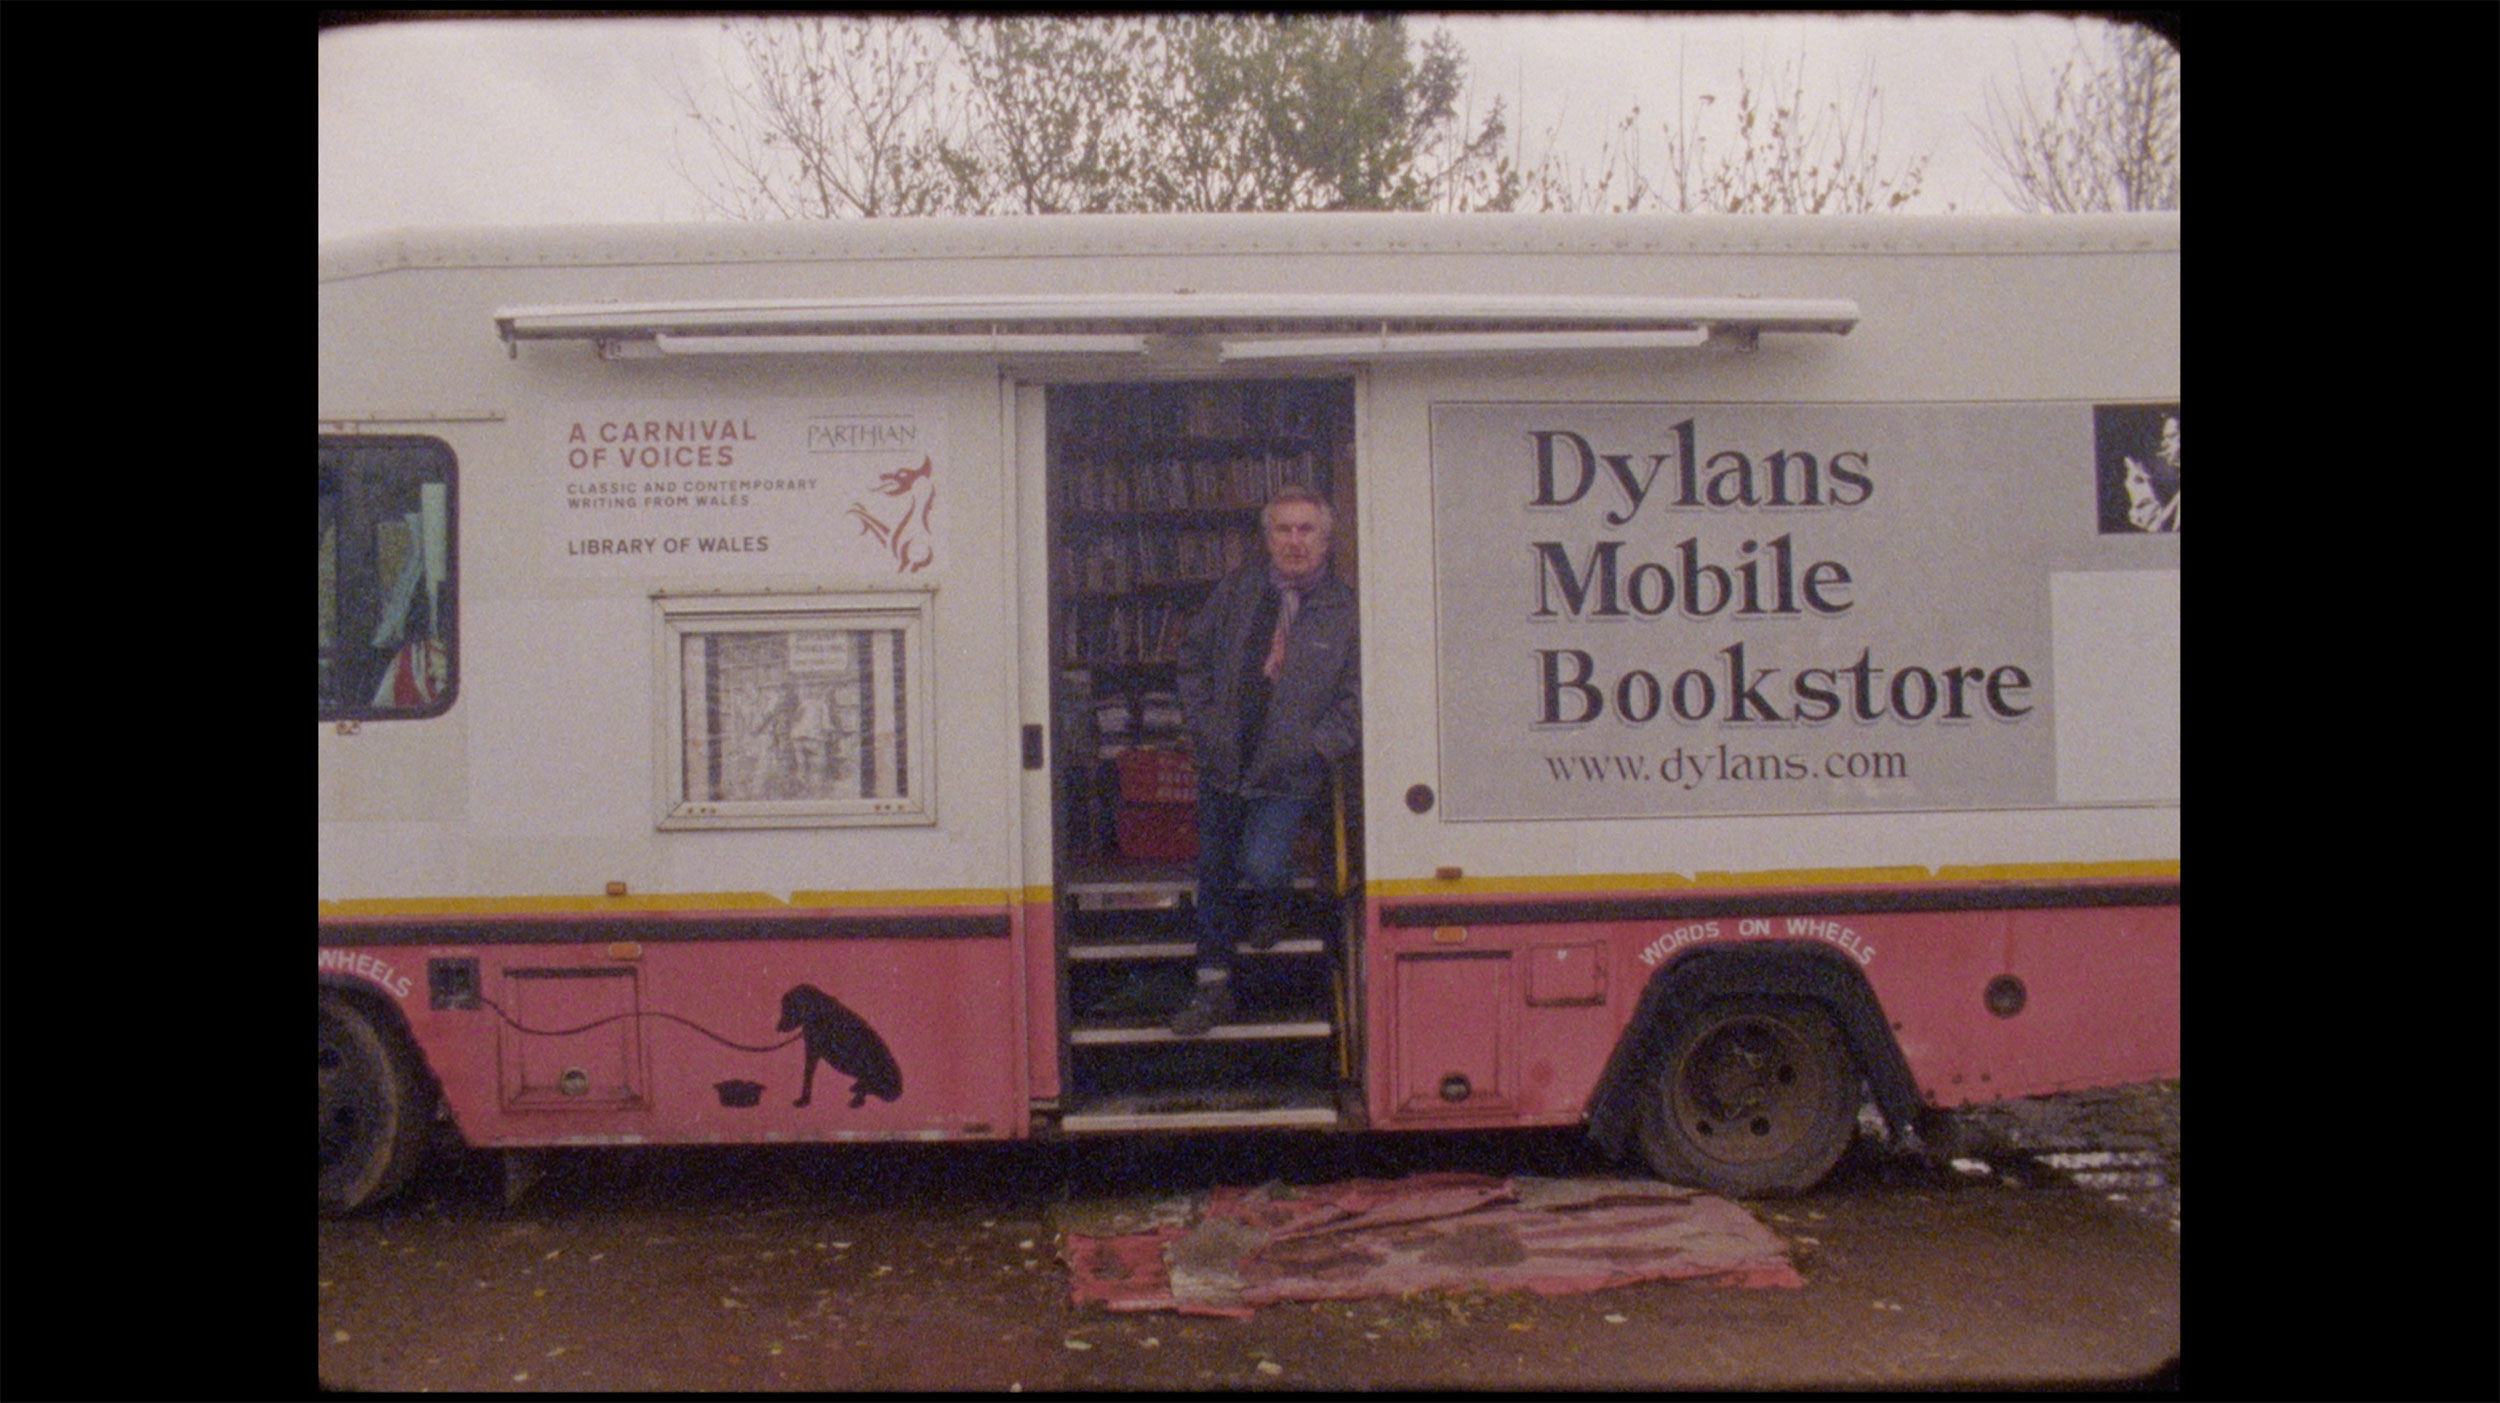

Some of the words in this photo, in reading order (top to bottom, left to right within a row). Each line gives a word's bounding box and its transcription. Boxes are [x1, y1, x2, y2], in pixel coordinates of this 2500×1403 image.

[568, 422, 587, 444] A
[599, 418, 757, 443] CARNIVAL
[807, 423, 918, 449] PARTHIAN
[568, 447, 607, 469] OF
[618, 445, 735, 469] VOICES
[1527, 416, 1875, 526] Dylans
[567, 481, 637, 496] CLASSIC
[644, 480, 678, 494] AND
[684, 477, 818, 493] CONTEMPORARY
[567, 496, 637, 509] WRITING
[644, 495, 689, 508] FROM
[695, 494, 750, 508] WALES
[568, 537, 656, 556] LIBRARY
[663, 537, 690, 555] OF
[698, 535, 770, 554] WALES
[1528, 532, 1855, 622] Mobile
[1530, 640, 2036, 730] Bookstore
[1545, 744, 1908, 790] www.dylans.com
[1637, 920, 1721, 966] WORDS
[1738, 918, 1771, 937] ON
[1786, 917, 1877, 966] WHEELS
[318, 949, 413, 998] WHEELS
